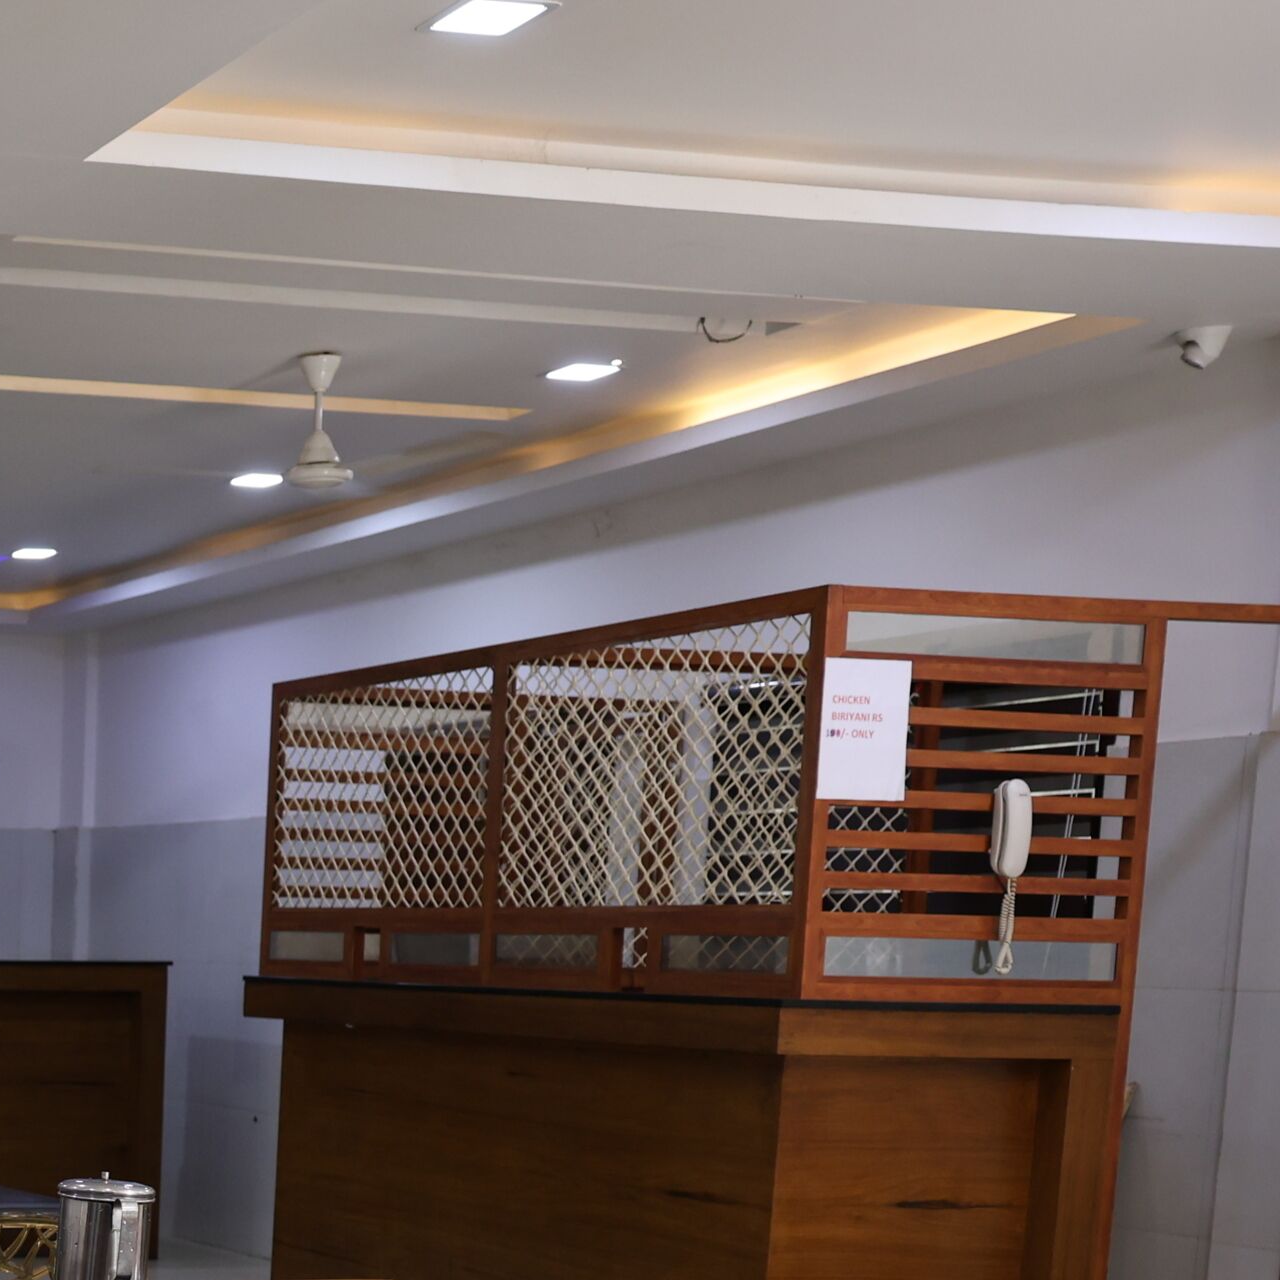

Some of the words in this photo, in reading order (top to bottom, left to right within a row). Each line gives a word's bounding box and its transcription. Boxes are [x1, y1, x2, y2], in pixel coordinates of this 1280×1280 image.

[832, 695, 871, 704] CHICKEN
[831, 711, 870, 721] BIRIYANI
[851, 729, 875, 739] ONLY
